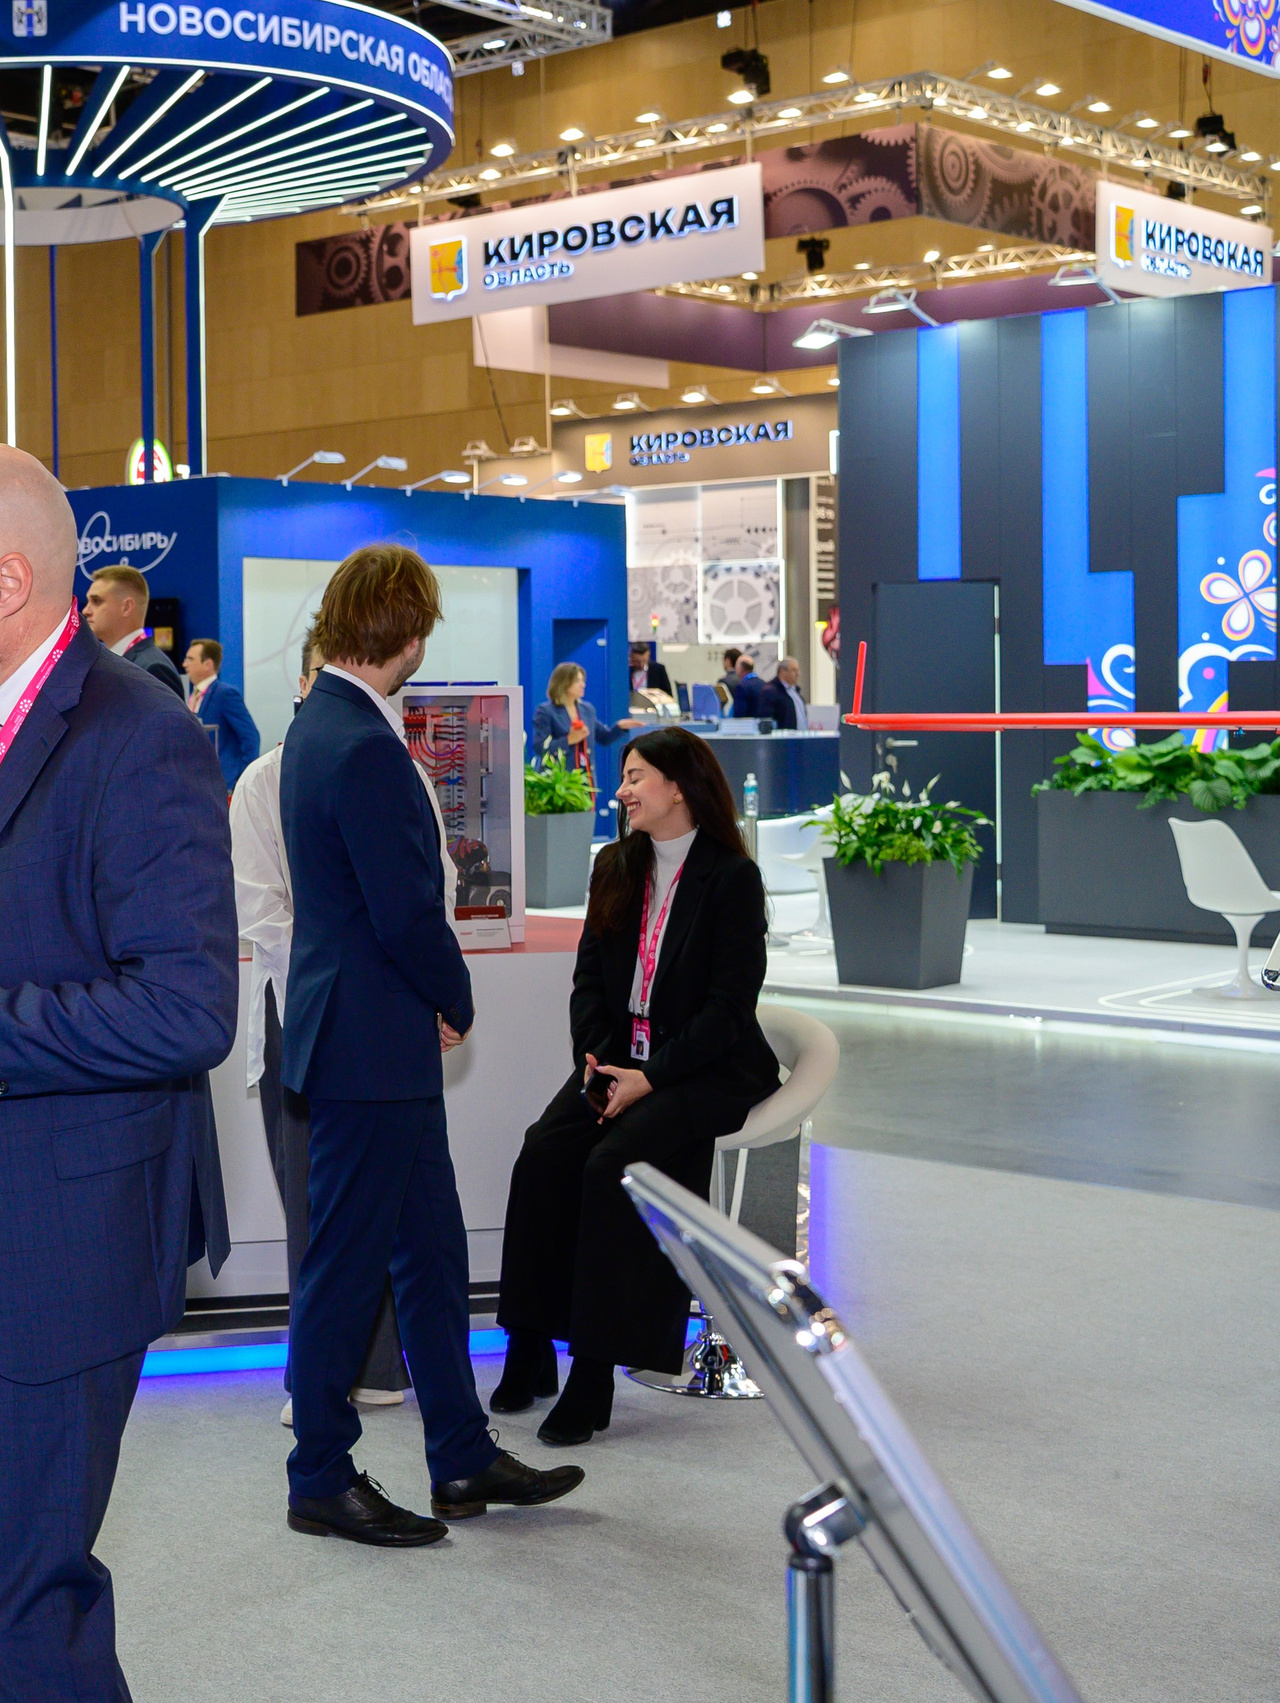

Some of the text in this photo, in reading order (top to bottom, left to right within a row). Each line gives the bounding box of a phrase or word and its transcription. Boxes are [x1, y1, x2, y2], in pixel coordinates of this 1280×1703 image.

[120, 2, 405, 75] НОВОСИБИРСКАЯ
[483, 195, 739, 268] КИРОВСКАЯ
[1141, 218, 1263, 277] КИРОВСКАЯ
[483, 259, 574, 290] ОБЛАСТЬ
[630, 419, 793, 455] КИРОВСКАЯ
[77, 532, 169, 554] ВОСИБИРЬ
